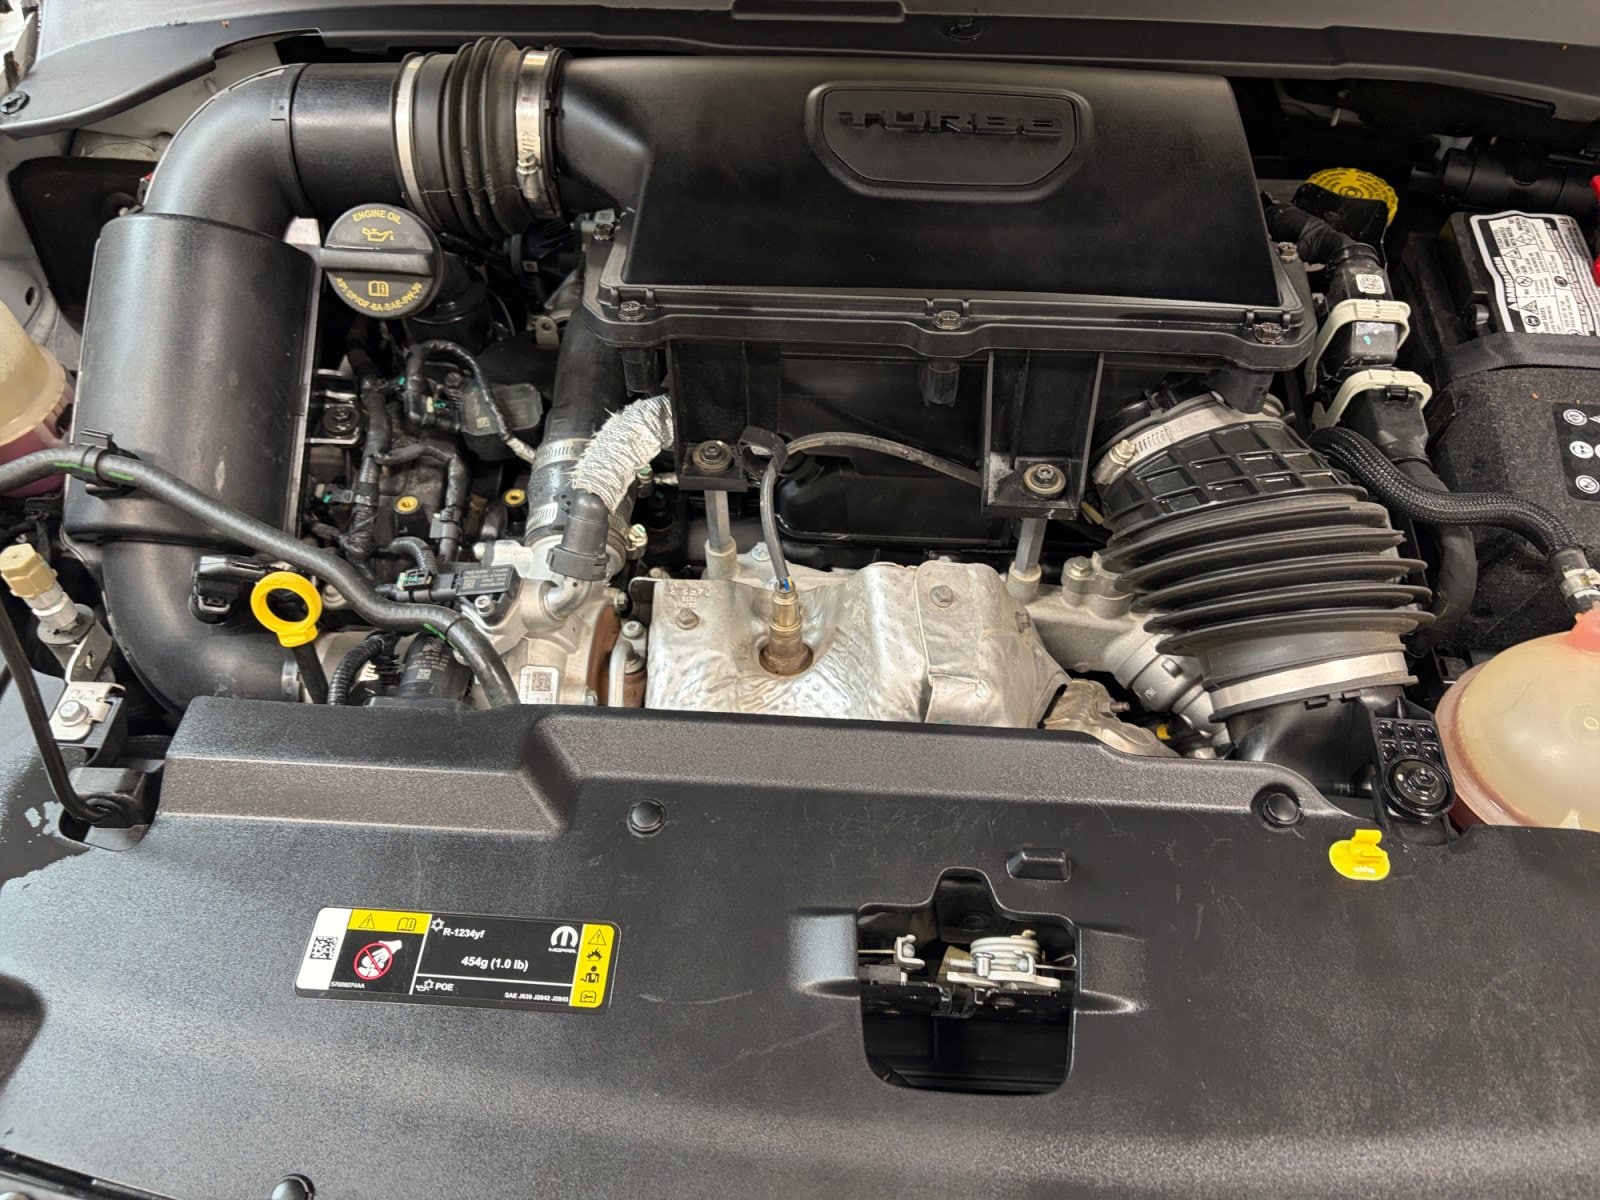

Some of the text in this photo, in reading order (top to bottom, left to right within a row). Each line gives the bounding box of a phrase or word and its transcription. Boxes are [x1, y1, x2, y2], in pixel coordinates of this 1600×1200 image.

[352, 209, 401, 225] ENGINE OIL
[442, 927, 486, 941] R-1234yf
[461, 956, 529, 972] 454g (1.0 lb)
[435, 982, 454, 992] POE
